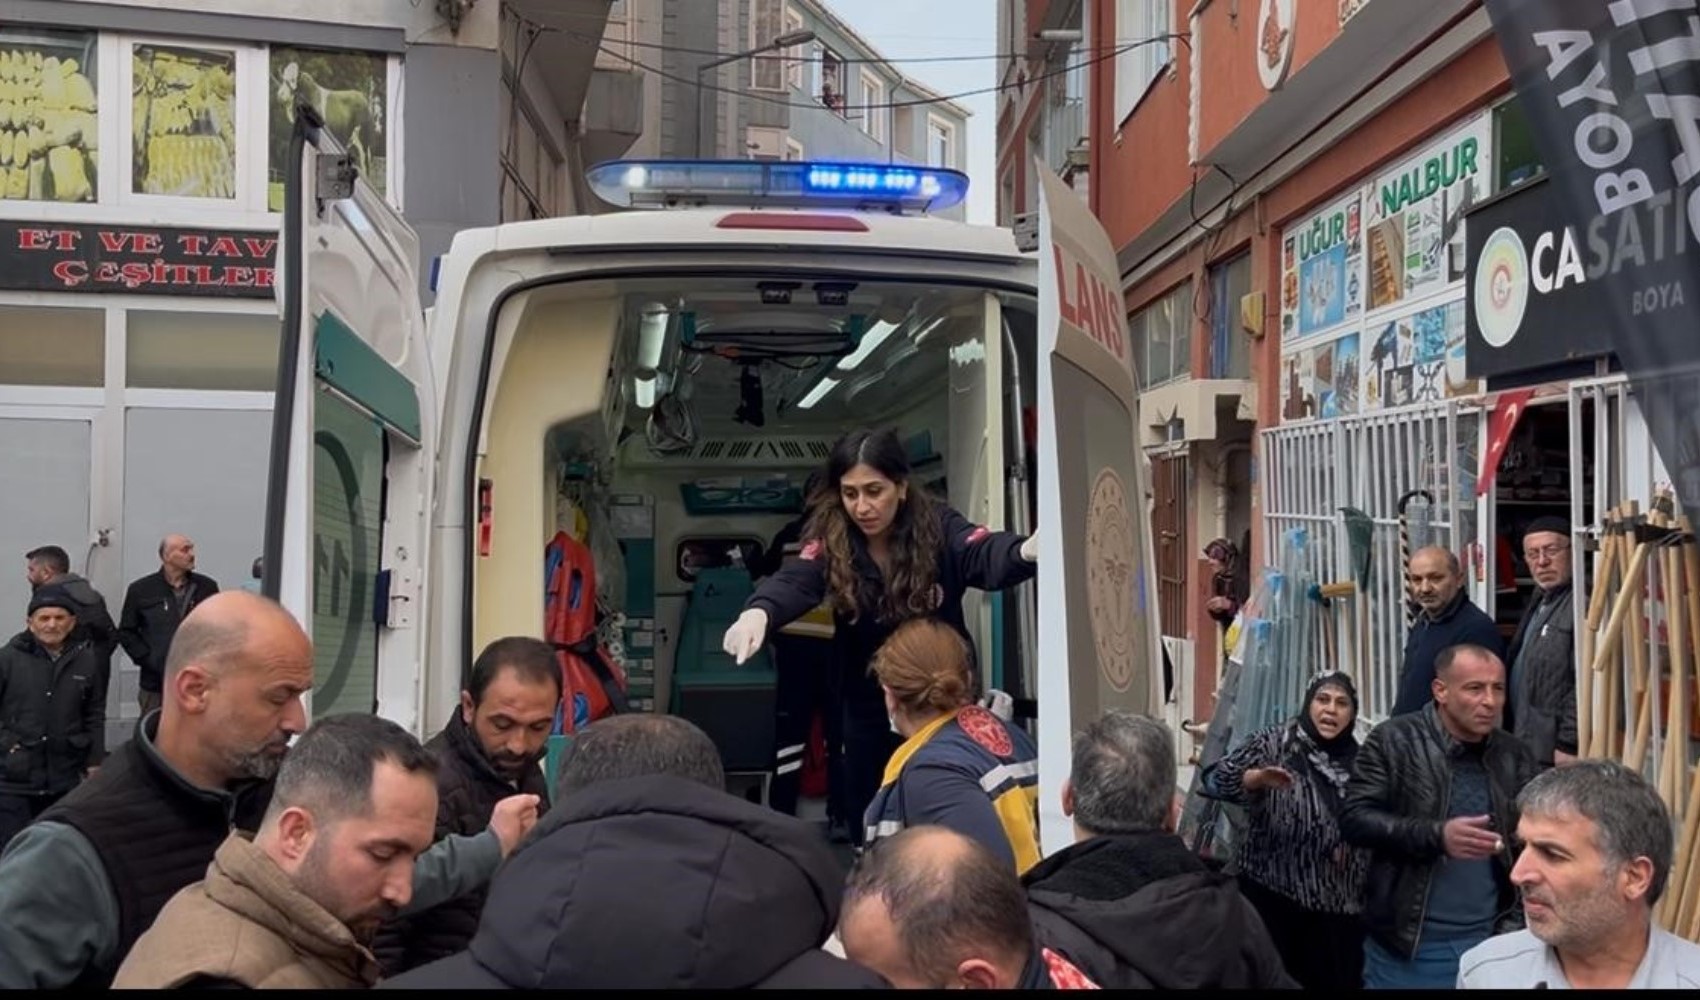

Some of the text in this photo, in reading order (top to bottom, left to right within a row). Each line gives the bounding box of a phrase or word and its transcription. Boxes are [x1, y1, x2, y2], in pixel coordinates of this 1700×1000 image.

[1532, 30, 1654, 216] BOYA
[1382, 136, 1478, 219] NALBUR
[18, 228, 82, 250] ET
[98, 231, 163, 253] VE
[1299, 211, 1345, 261] UĞUR
[1053, 243, 1125, 359] LANS
[1632, 280, 1685, 316] BOYA
